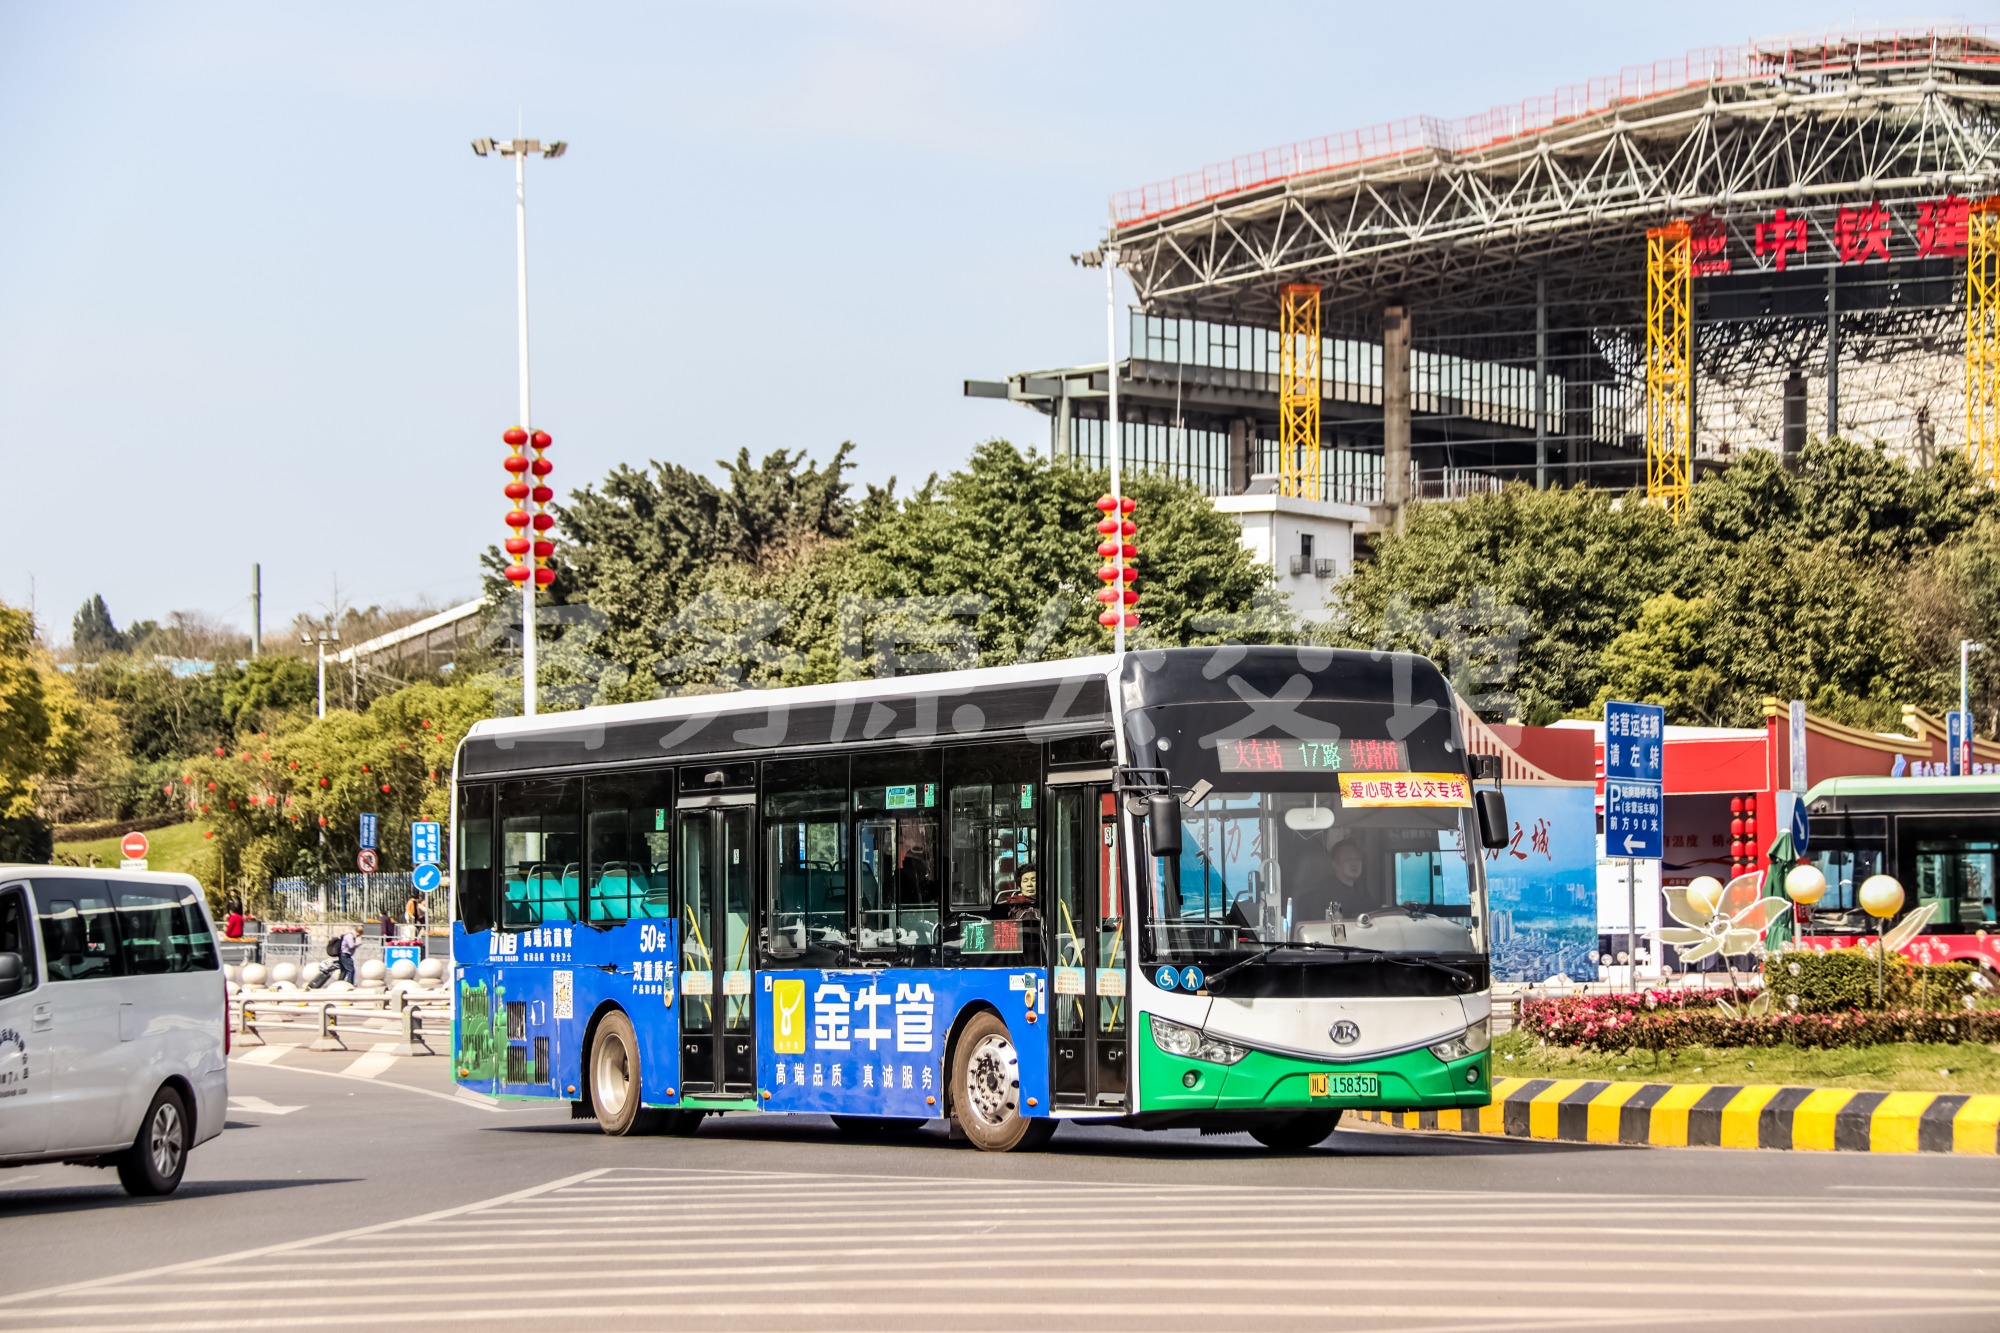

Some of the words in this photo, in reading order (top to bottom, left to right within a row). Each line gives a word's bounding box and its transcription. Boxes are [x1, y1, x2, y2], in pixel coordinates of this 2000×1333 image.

[1755, 195, 1969, 271] 中铁建
[1610, 712, 1660, 739] 非营运车辆
[1235, 739, 1283, 769] 火车站
[1299, 742, 1342, 770] 17路
[1350, 740, 1399, 770] 铁路桥
[1610, 743, 1660, 769] 请左转
[1350, 781, 1464, 799] 爱心敬老公交专线
[1610, 784, 1621, 813] P
[1622, 785, 1659, 800] 站南路停车场
[1610, 816, 1659, 832] 前方90米
[640, 924, 667, 953] 50年
[814, 983, 934, 1052] 金牛管
[775, 1062, 842, 1087] 高端品质
[863, 1064, 933, 1090] 真诚服务
